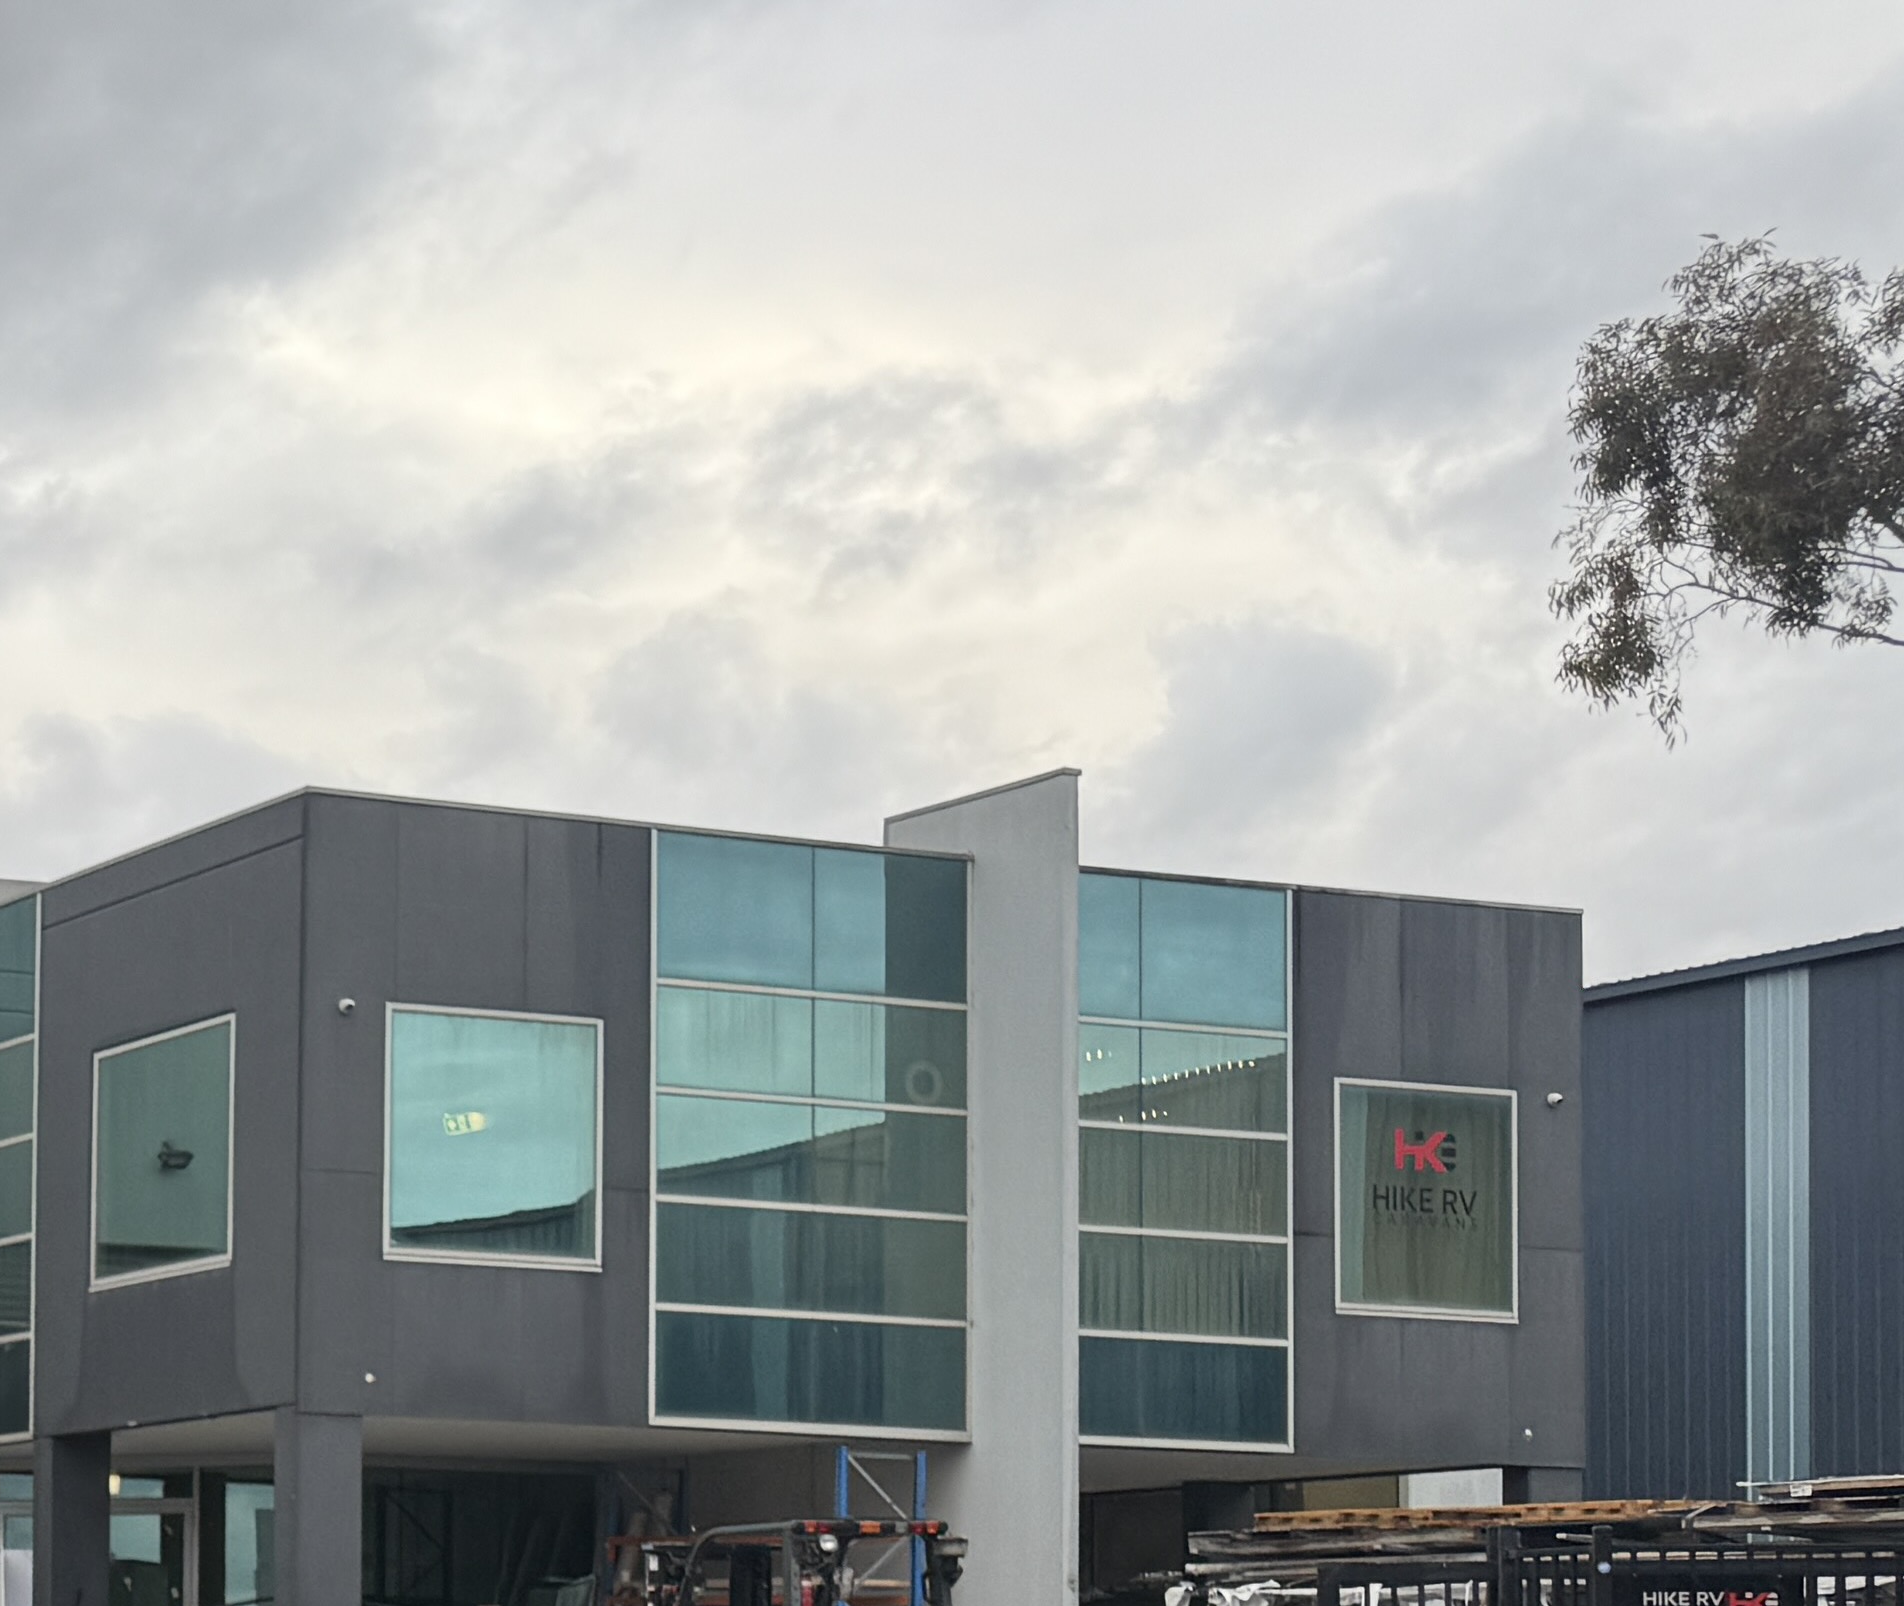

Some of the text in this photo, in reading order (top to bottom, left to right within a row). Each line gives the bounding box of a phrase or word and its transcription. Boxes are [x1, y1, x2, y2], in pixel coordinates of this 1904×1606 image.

[1373, 1184, 1477, 1217] HIKE RV
[1643, 1591, 1691, 1606] HIKE
[1696, 1591, 1725, 1606] RV
